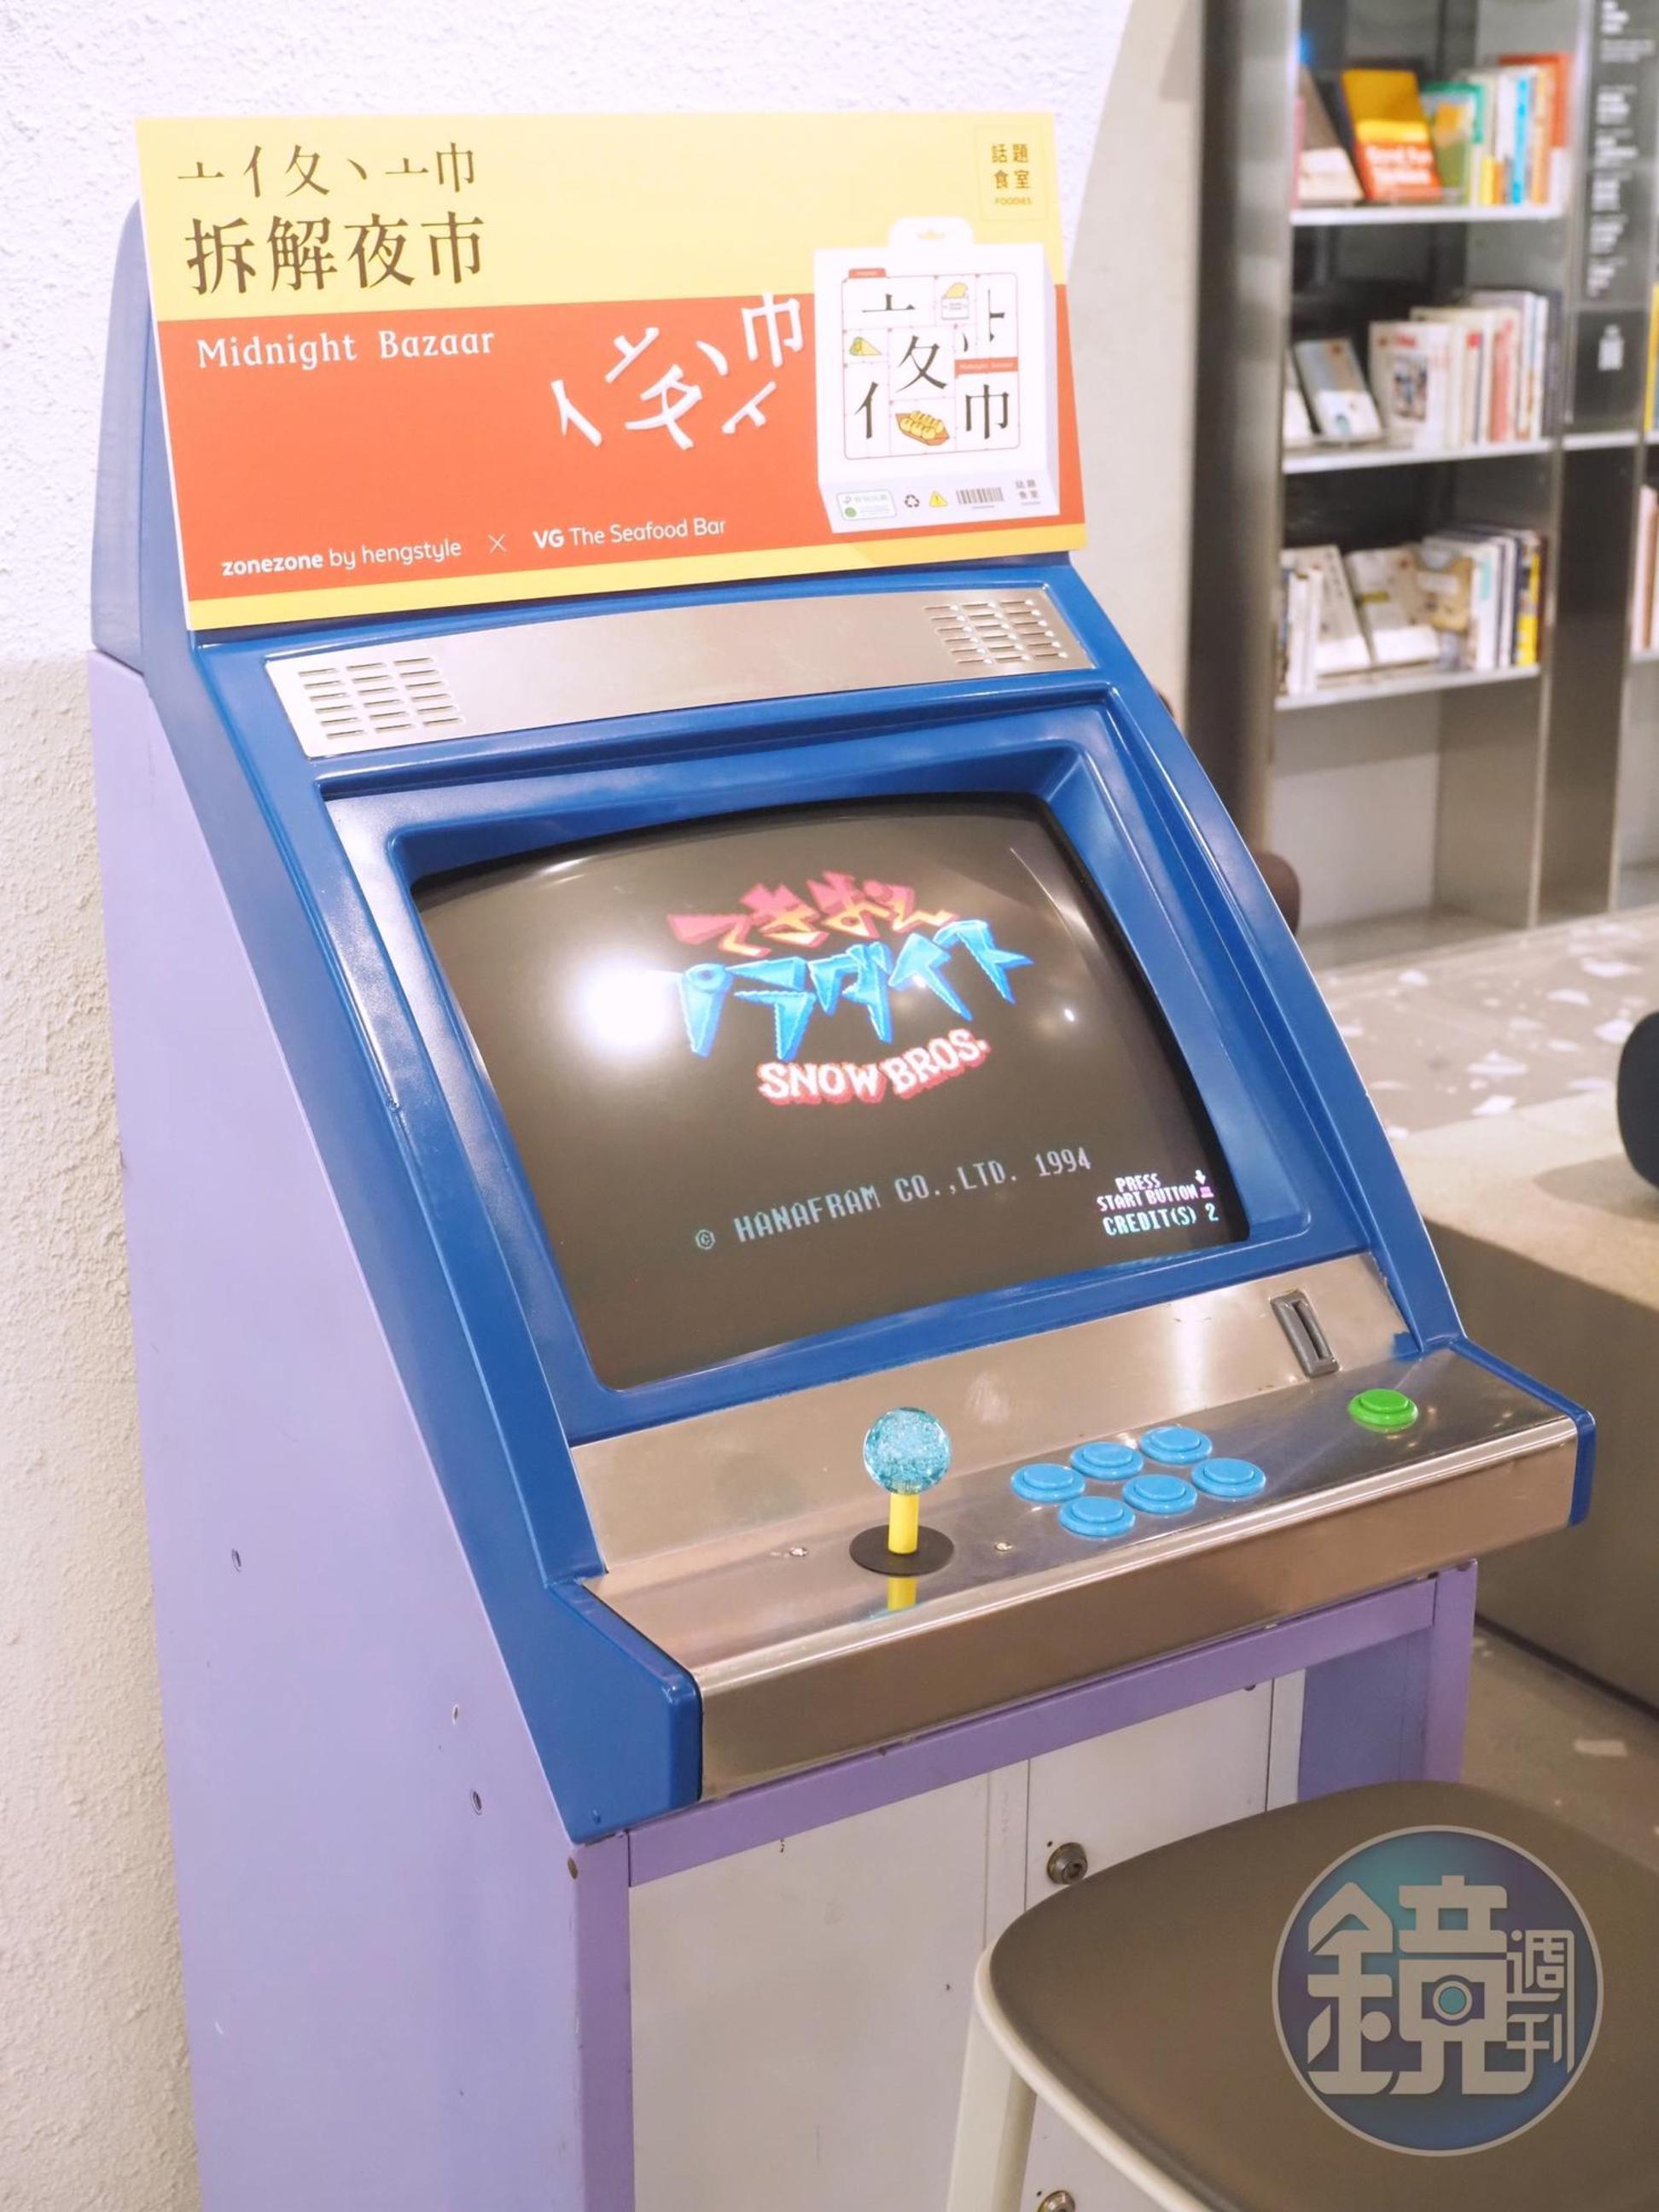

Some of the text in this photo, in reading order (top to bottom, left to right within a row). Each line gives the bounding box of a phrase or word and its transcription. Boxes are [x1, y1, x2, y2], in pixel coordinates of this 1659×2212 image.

[184, 211, 484, 295] 拆解夜市
[197, 329, 495, 370] Midnight Bazaar
[222, 553, 323, 576] zonezone
[329, 548, 356, 570] by
[361, 538, 462, 565] hengstyle
[533, 529, 565, 549] VG
[568, 526, 605, 546] The
[609, 519, 688, 544] Seafood
[693, 516, 725, 537] Bar
[758, 1028, 990, 1105] SNOW BROS.
[734, 1185, 882, 1243] HANAFRAM
[1034, 1147, 1091, 1177] 1994
[1097, 1184, 1199, 1212] START BUTTON
[1115, 1173, 1161, 1193] PRESS
[1103, 1202, 1220, 1237] CREDIT(S) 2
